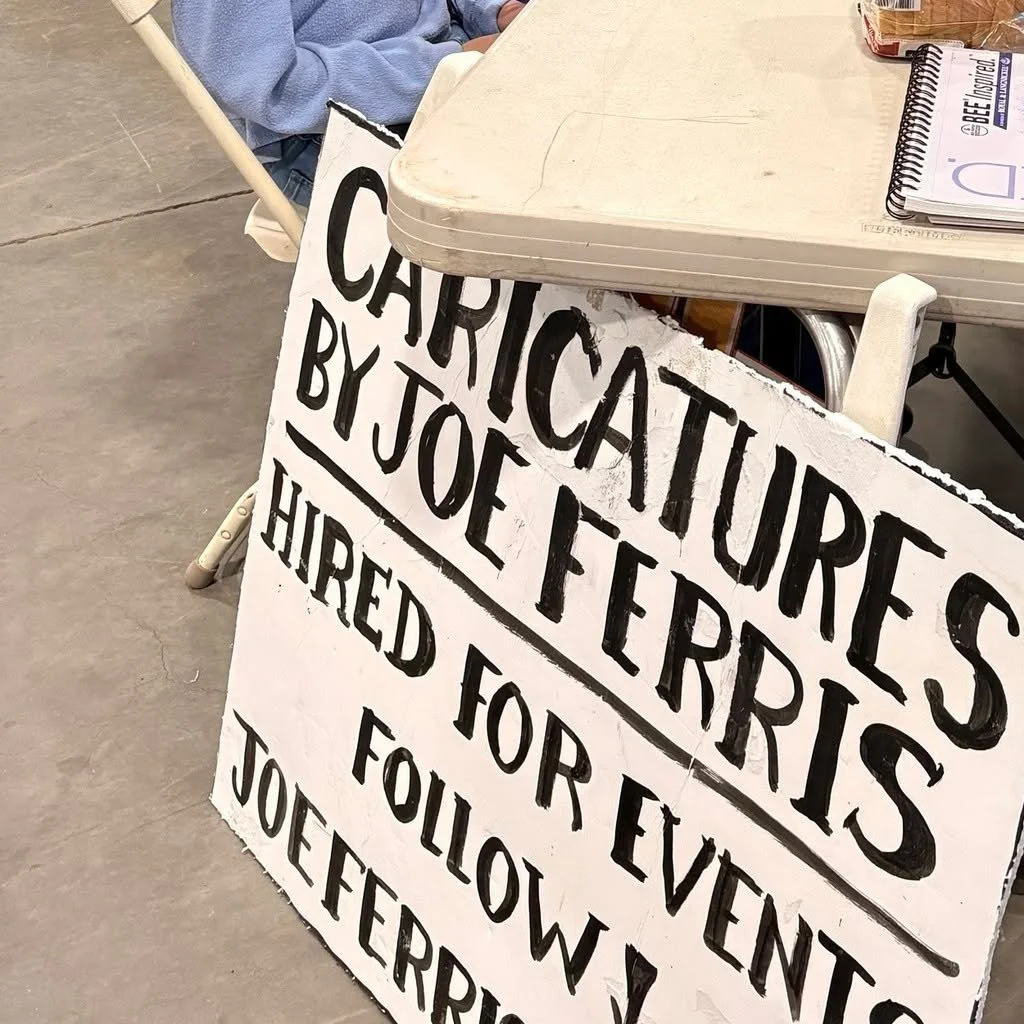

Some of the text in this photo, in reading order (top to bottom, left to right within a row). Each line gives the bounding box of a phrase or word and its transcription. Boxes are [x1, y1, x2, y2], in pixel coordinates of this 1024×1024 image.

[260, 458, 924, 1024] HIRED FOR EVENT
[296, 298, 945, 881] BY JOE FERRIS
[326, 166, 1019, 751] CARICATURES
[232, 709, 526, 1024] JOEFERR
[352, 706, 610, 996] FOLLOW
